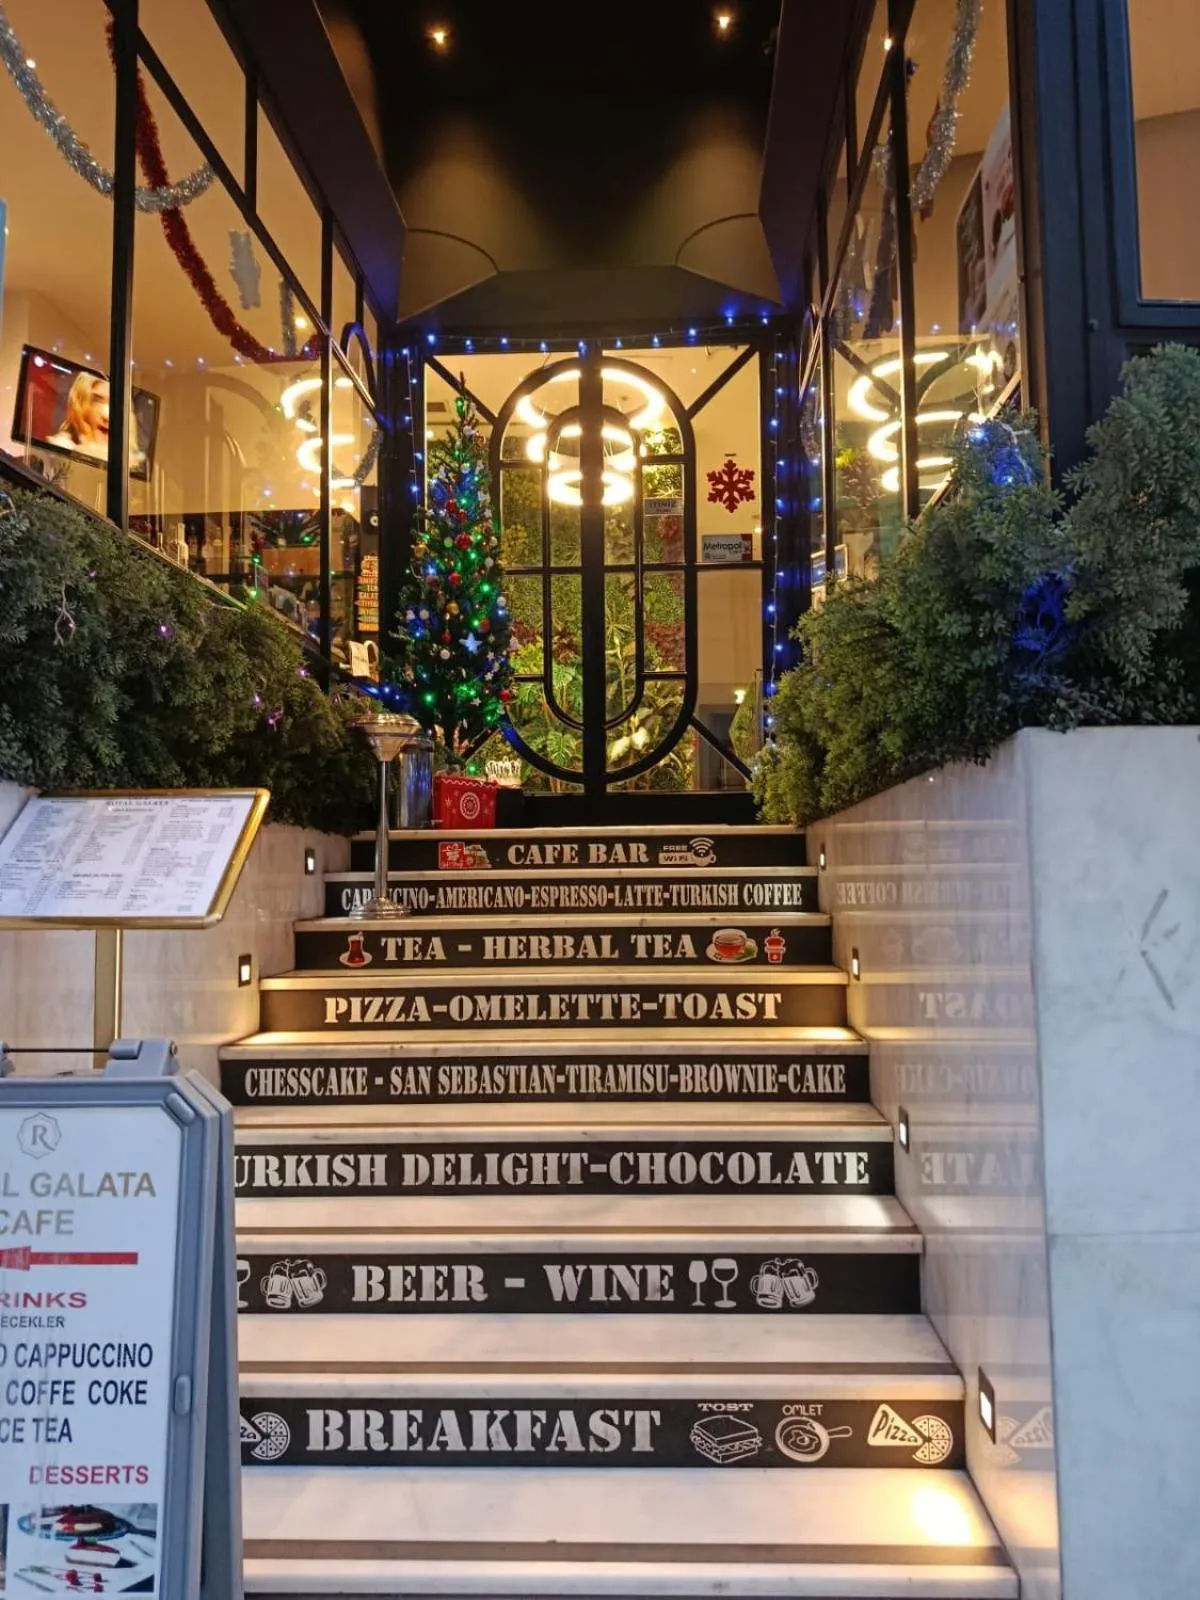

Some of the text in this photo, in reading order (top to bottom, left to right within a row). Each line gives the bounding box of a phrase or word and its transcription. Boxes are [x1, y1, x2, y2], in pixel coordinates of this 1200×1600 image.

[507, 842, 650, 865] CAFE BAR
[743, 883, 803, 906] COFFEE
[381, 936, 447, 961] TEA
[482, 934, 619, 960] HERBAL
[630, 934, 698, 959] TEA
[324, 992, 782, 1024] PIZZA-OMELETTE-TOAST
[244, 1066, 368, 1098] CHESSCAKE
[390, 1065, 431, 1096] SAN
[401, 1152, 870, 1186] DELIGHT-CHOCOLATE
[30, 1171, 157, 1198] GALATA
[351, 1264, 488, 1302] BEER
[543, 1264, 675, 1302] WINE
[14, 1342, 154, 1369] CAPPUCCINO
[6, 1379, 149, 1406] COFFE COKE
[697, 1403, 754, 1412] TOST
[782, 1404, 824, 1417] OMLET
[32, 1417, 73, 1444] TEA
[306, 1409, 661, 1453] BREAKFAST
[871, 1408, 919, 1444] Pizza
[29, 1464, 149, 1486] DESSERTS
